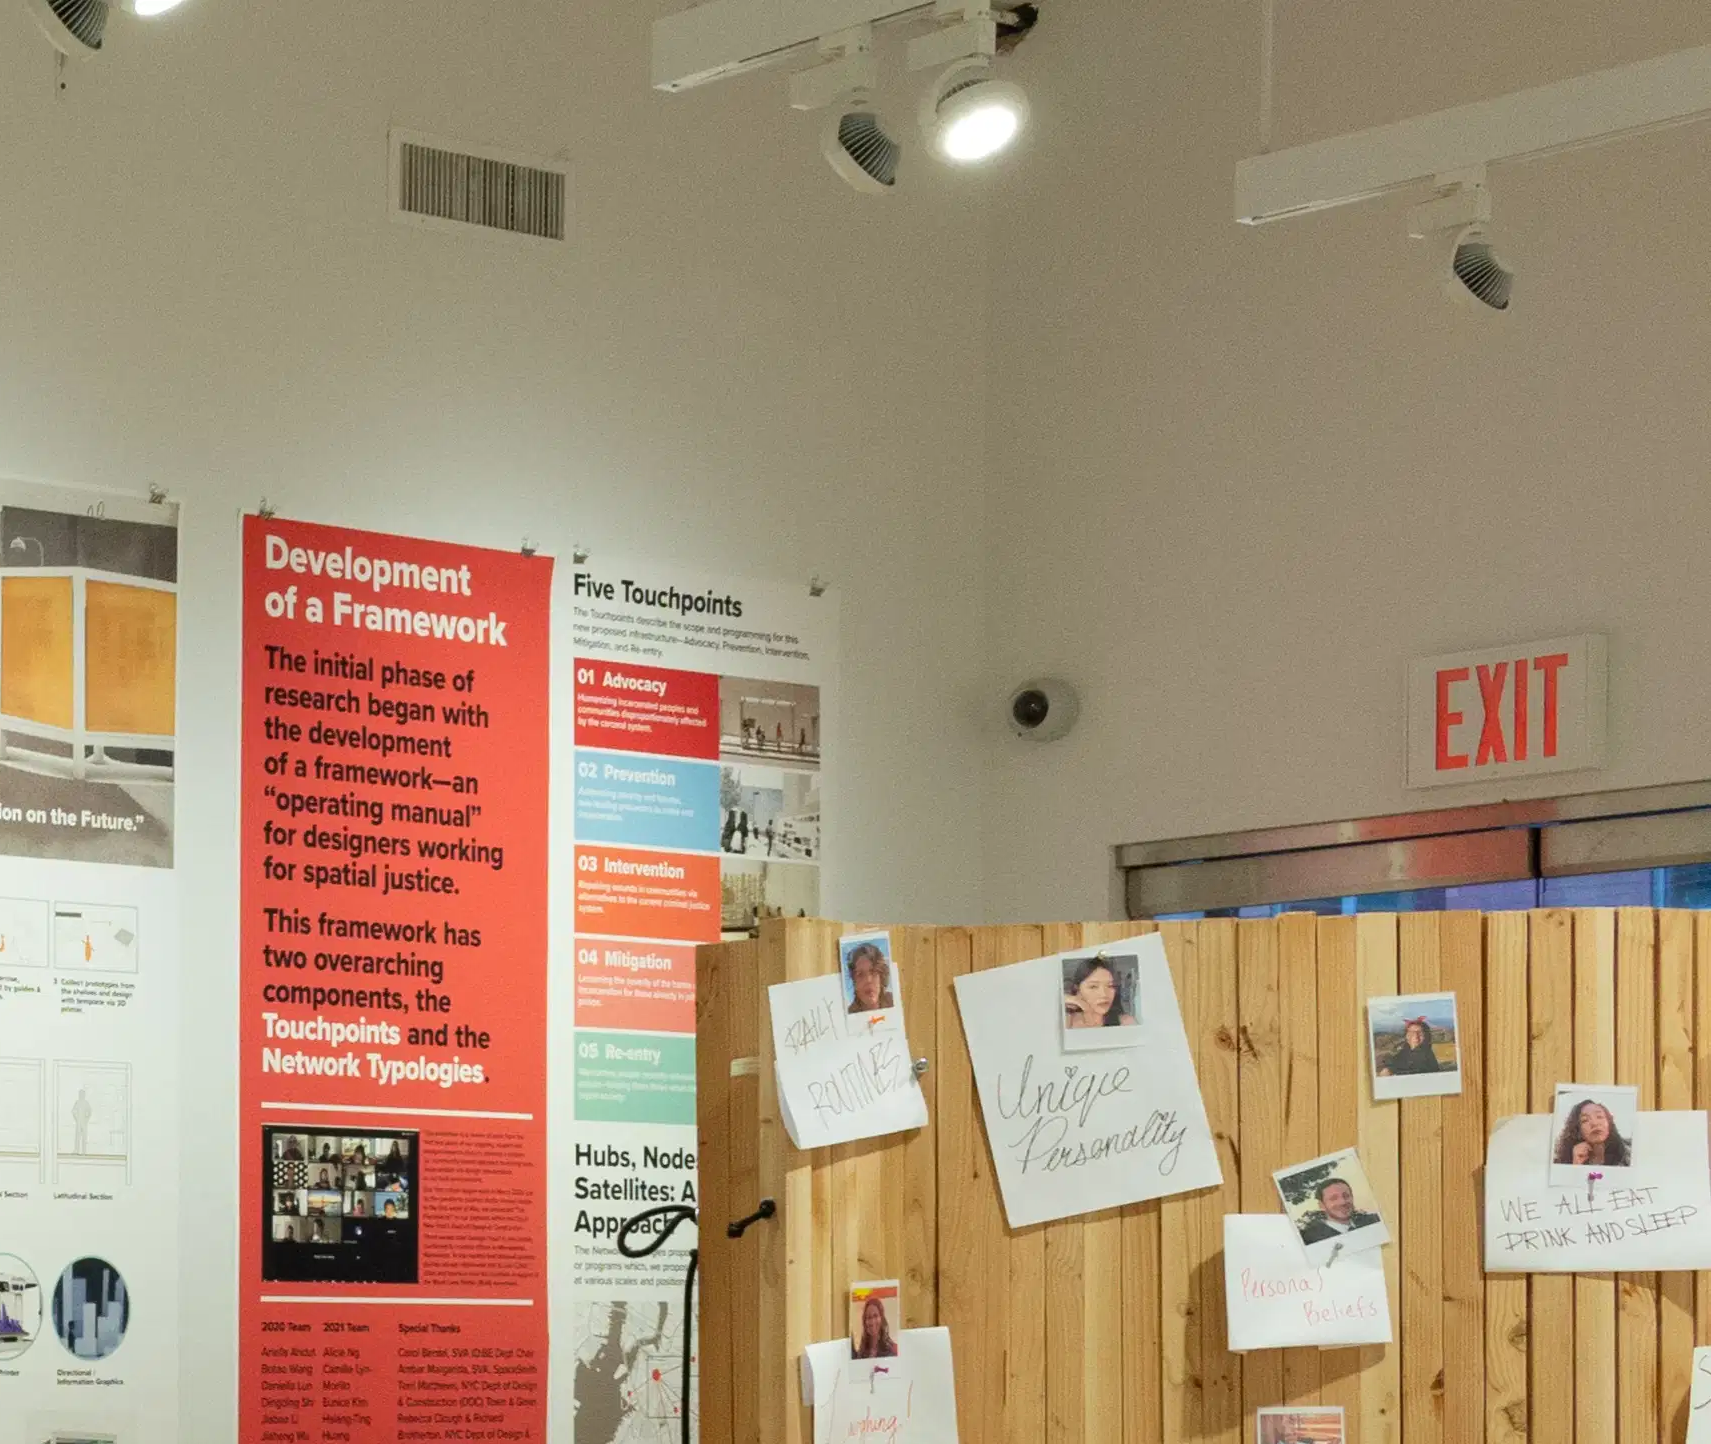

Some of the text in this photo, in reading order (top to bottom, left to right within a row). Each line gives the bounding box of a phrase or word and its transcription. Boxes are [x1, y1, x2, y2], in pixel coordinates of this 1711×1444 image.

[266, 535, 471, 596] Development
[574, 573, 742, 618] Five Touchpoints
[265, 586, 507, 646] of a Framework
[264, 643, 474, 692] The initial phase of
[577, 666, 666, 695] 01 Advocacy
[1434, 652, 1569, 771] EXIT
[578, 761, 676, 788] 02 Prevention
[25, 808, 46, 824] on
[48, 807, 76, 827] the
[80, 810, 145, 833] Future.”
[578, 855, 684, 878] 03 Intervention
[578, 948, 671, 971] 04 Mitigation
[262, 1012, 490, 1049] Touchpoints and the
[262, 1047, 489, 1088] Network Typologies.
[578, 1041, 661, 1065] 05 Re-entry
[997, 1054, 1134, 1128] Unique
[574, 1144, 699, 1171] Hubs, Node
[1008, 1109, 1188, 1177] Personality
[574, 1177, 676, 1202] Satellites:
[1500, 1196, 1542, 1223] WE
[1608, 1186, 1659, 1212] EAT
[1496, 1227, 1578, 1252] DRINK
[1240, 1267, 1324, 1302] Personal
[1303, 1296, 1378, 1326] Beliefs
